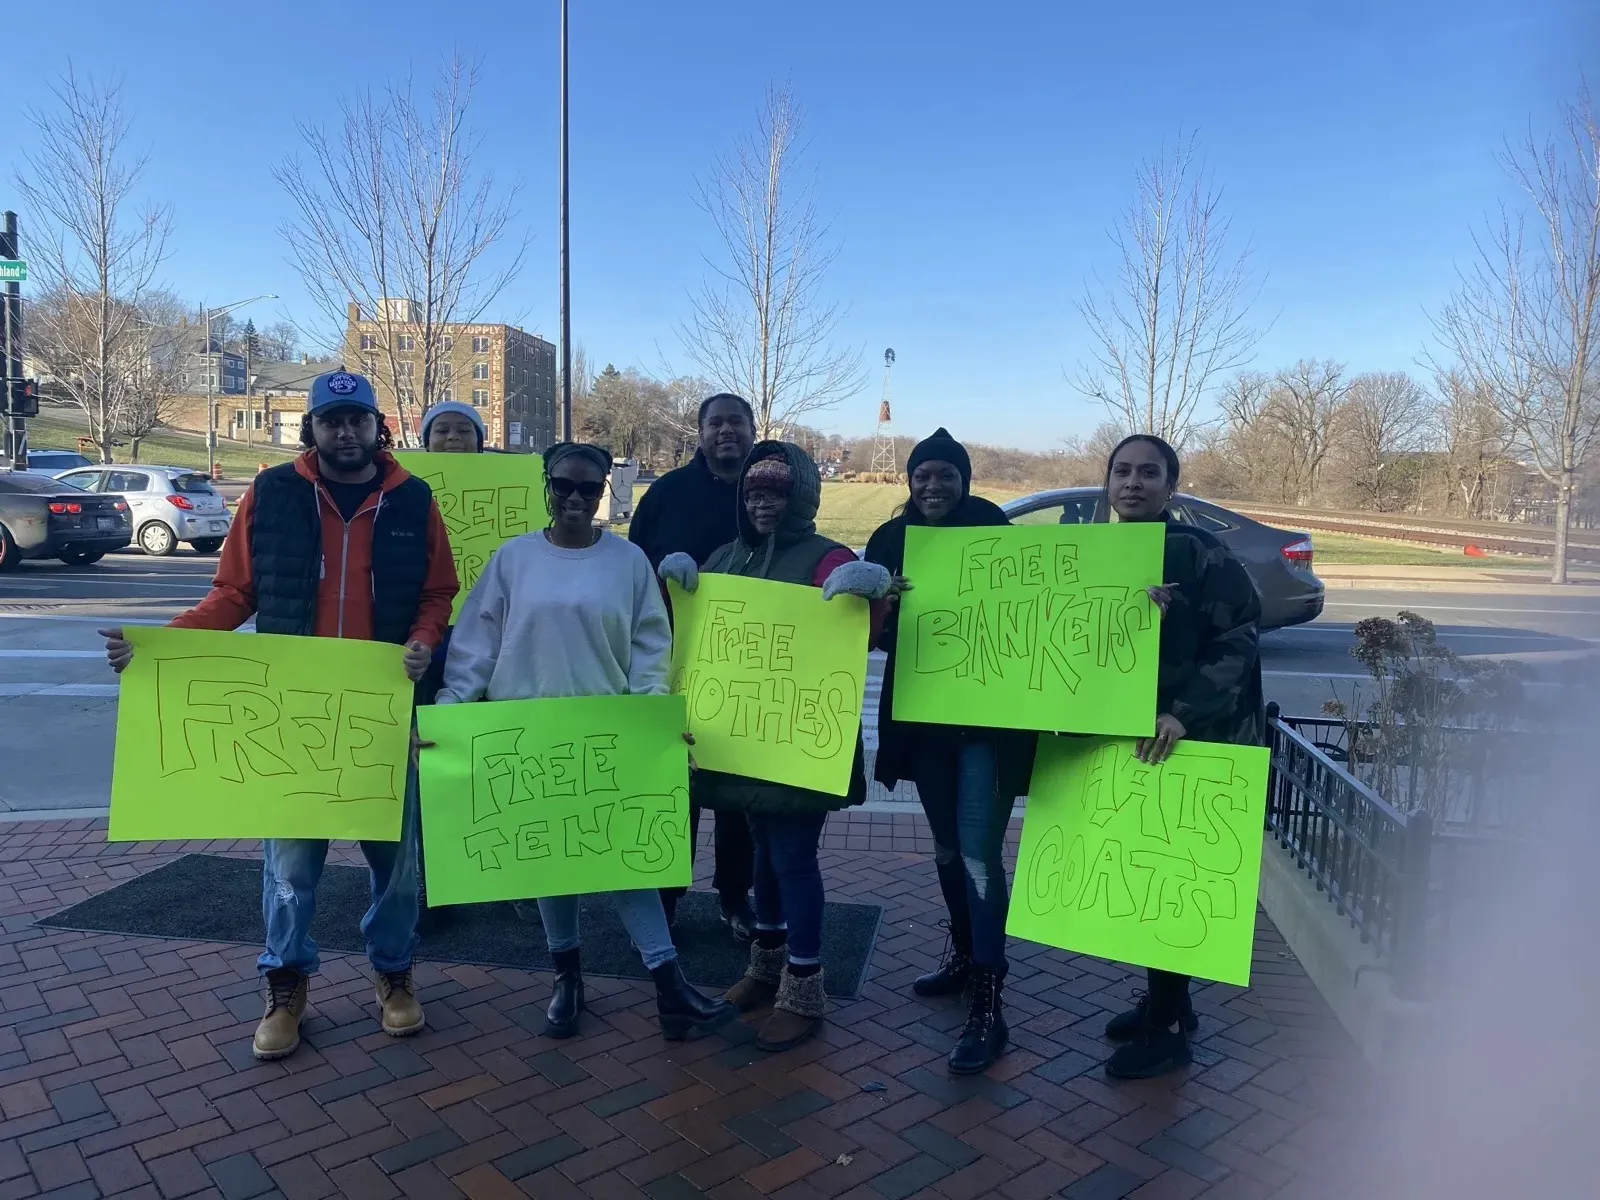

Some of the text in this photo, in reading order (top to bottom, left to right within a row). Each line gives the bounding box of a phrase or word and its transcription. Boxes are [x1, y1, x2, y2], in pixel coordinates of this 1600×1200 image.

[154, 655, 399, 803] FREE
[463, 786, 690, 874] TENTS
[1081, 743, 1249, 875] HATS
[1027, 824, 1237, 949] COATS
